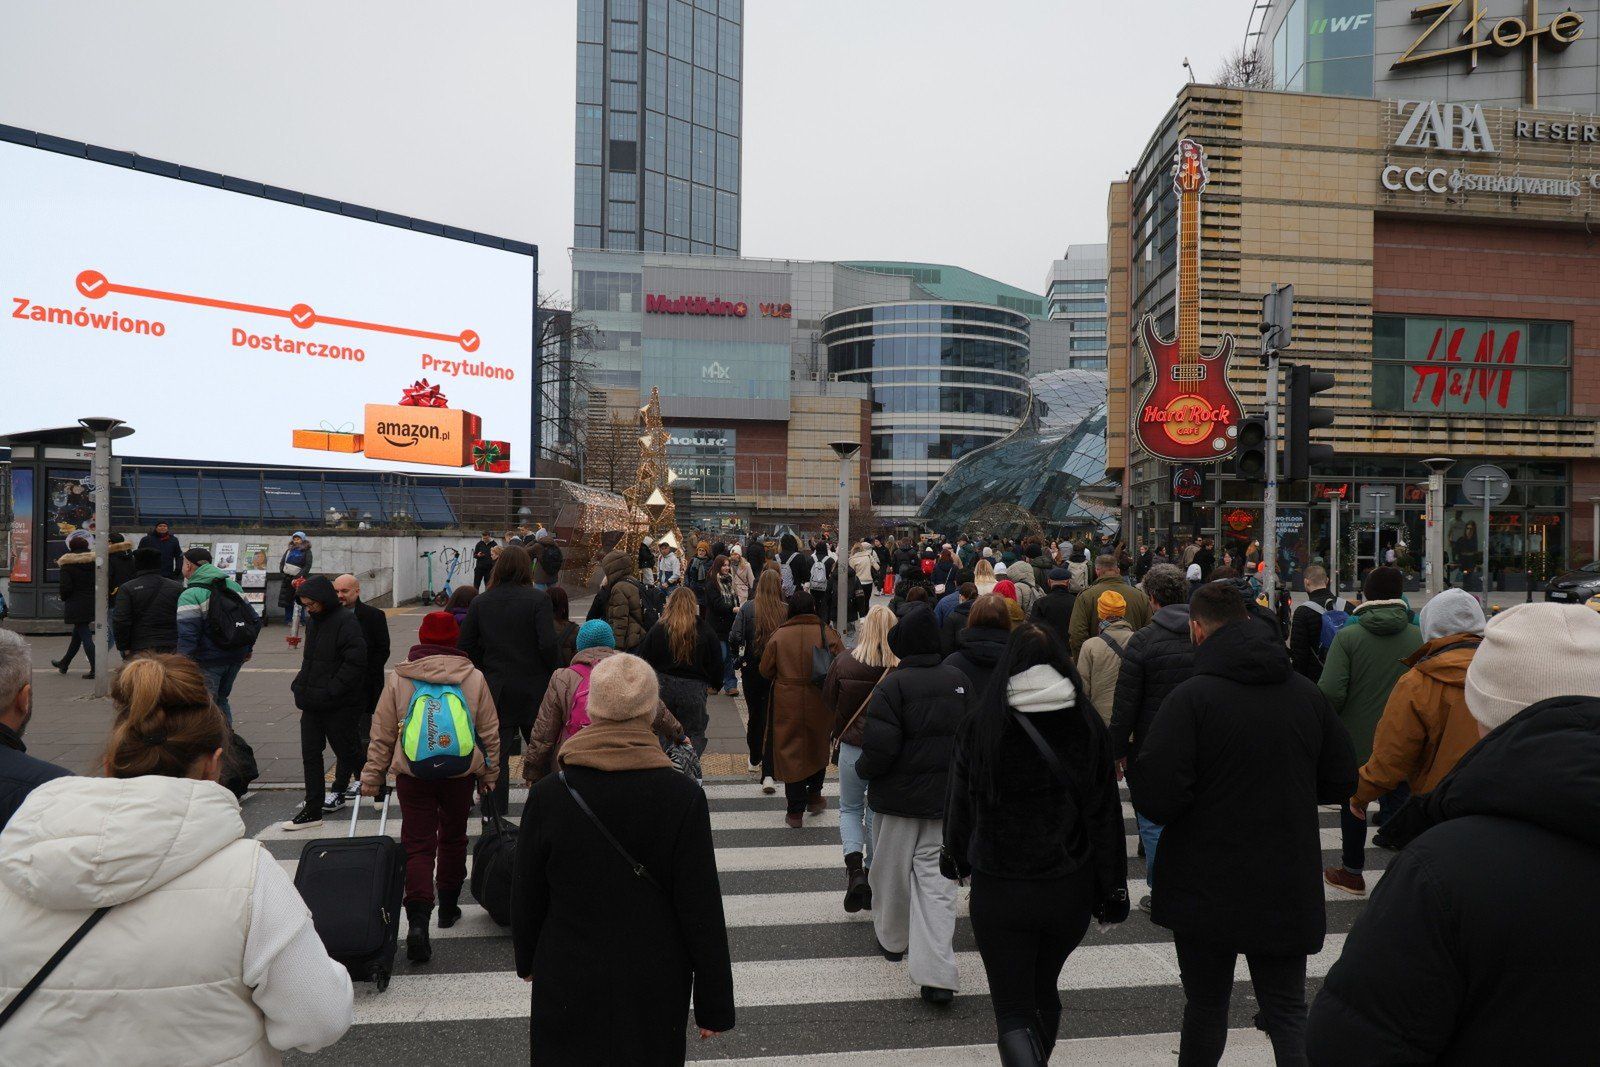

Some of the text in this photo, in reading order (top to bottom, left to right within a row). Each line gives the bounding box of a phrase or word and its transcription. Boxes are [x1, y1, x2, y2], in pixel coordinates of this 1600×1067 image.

[1395, 99, 1496, 152] ZARA
[1516, 120, 1600, 142] RESER
[1382, 165, 1448, 194] CCC
[1464, 173, 1581, 196] STRADIVARIUS
[12, 297, 166, 337] Zamówiono
[646, 293, 748, 317] Multikino
[232, 328, 366, 362] Dostarczono
[422, 353, 515, 381] Przytulono
[1412, 327, 1521, 409] H&M
[1144, 404, 1230, 425] Hard Rock
[377, 421, 450, 441] amazon.pl
[1177, 427, 1200, 435] CAFE
